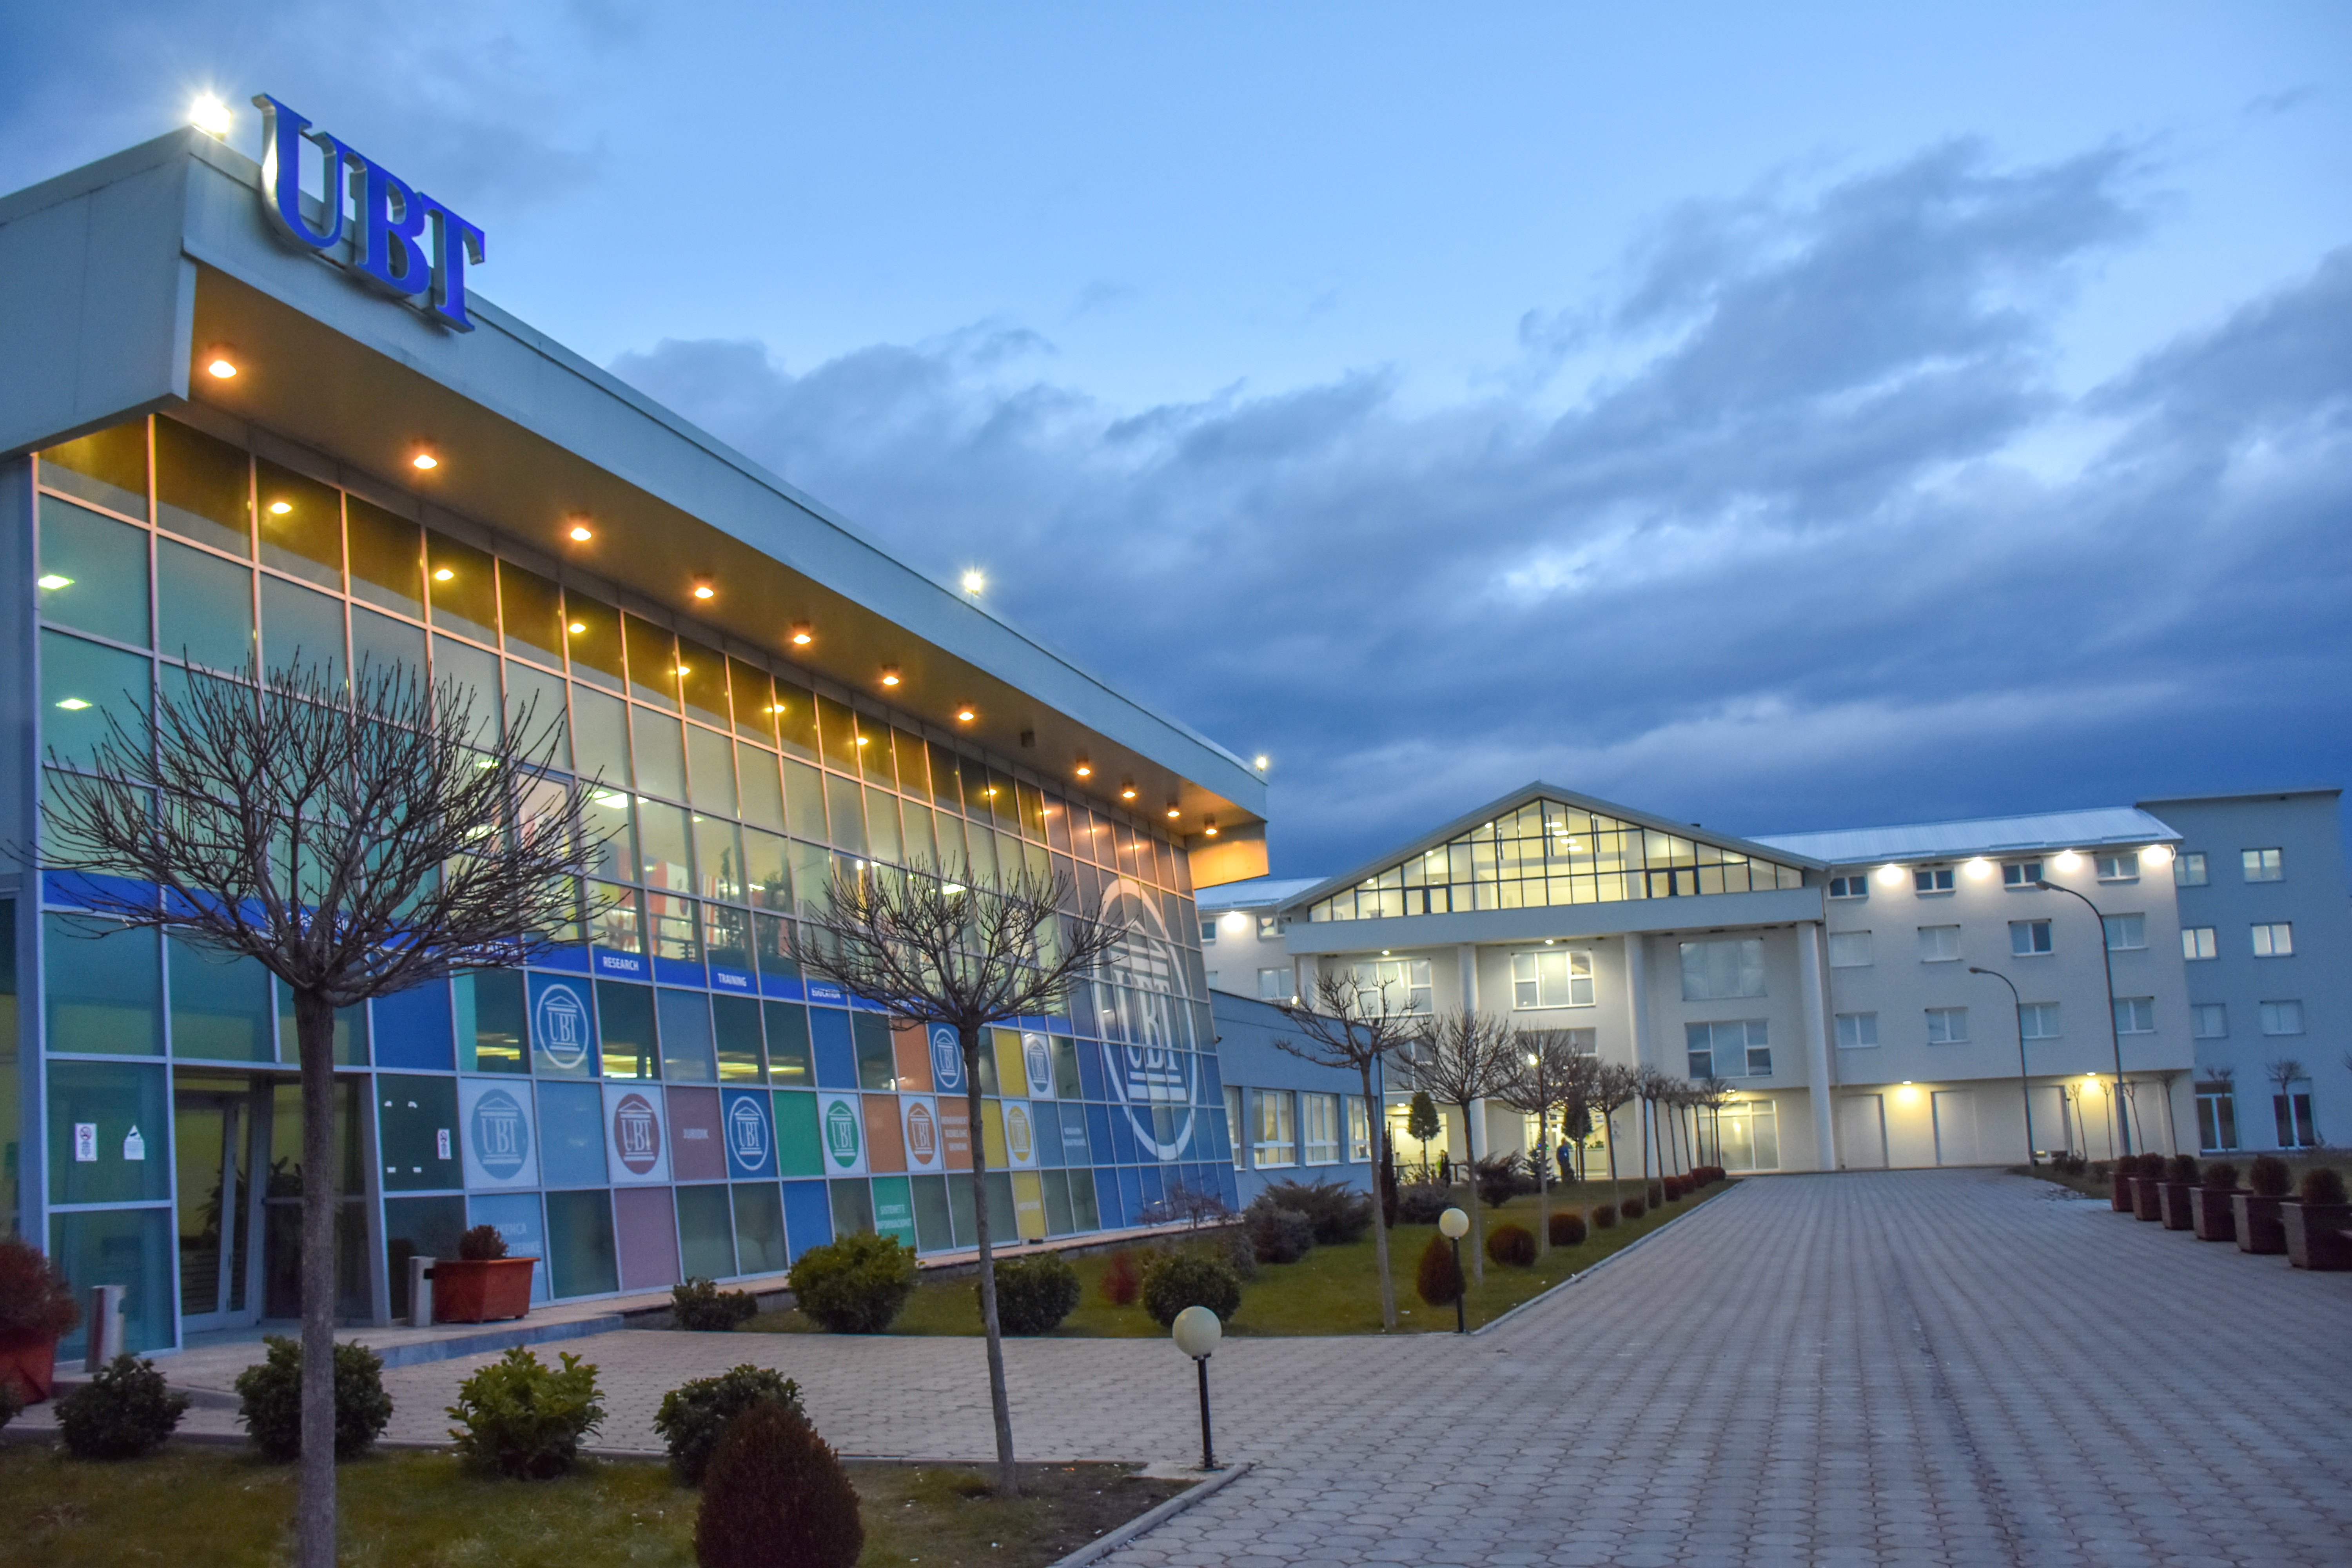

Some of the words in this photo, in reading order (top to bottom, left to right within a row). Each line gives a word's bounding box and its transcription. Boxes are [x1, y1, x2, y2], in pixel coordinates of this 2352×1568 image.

[252, 93, 485, 333] UBT
[603, 956, 639, 971] RESEARCH
[717, 973, 747, 987] TRAINING
[548, 1011, 578, 1044] UBT
[1113, 970, 1178, 1070] UBT
[939, 1048, 954, 1070] UBT
[1030, 1056, 1045, 1077] UBT
[481, 1118, 518, 1153] UBT
[622, 1118, 652, 1151] UBT
[737, 1121, 759, 1146] UBT
[831, 1121, 854, 1149] UBT
[911, 1121, 931, 1148] UBT
[1011, 1123, 1028, 1147] UBT
